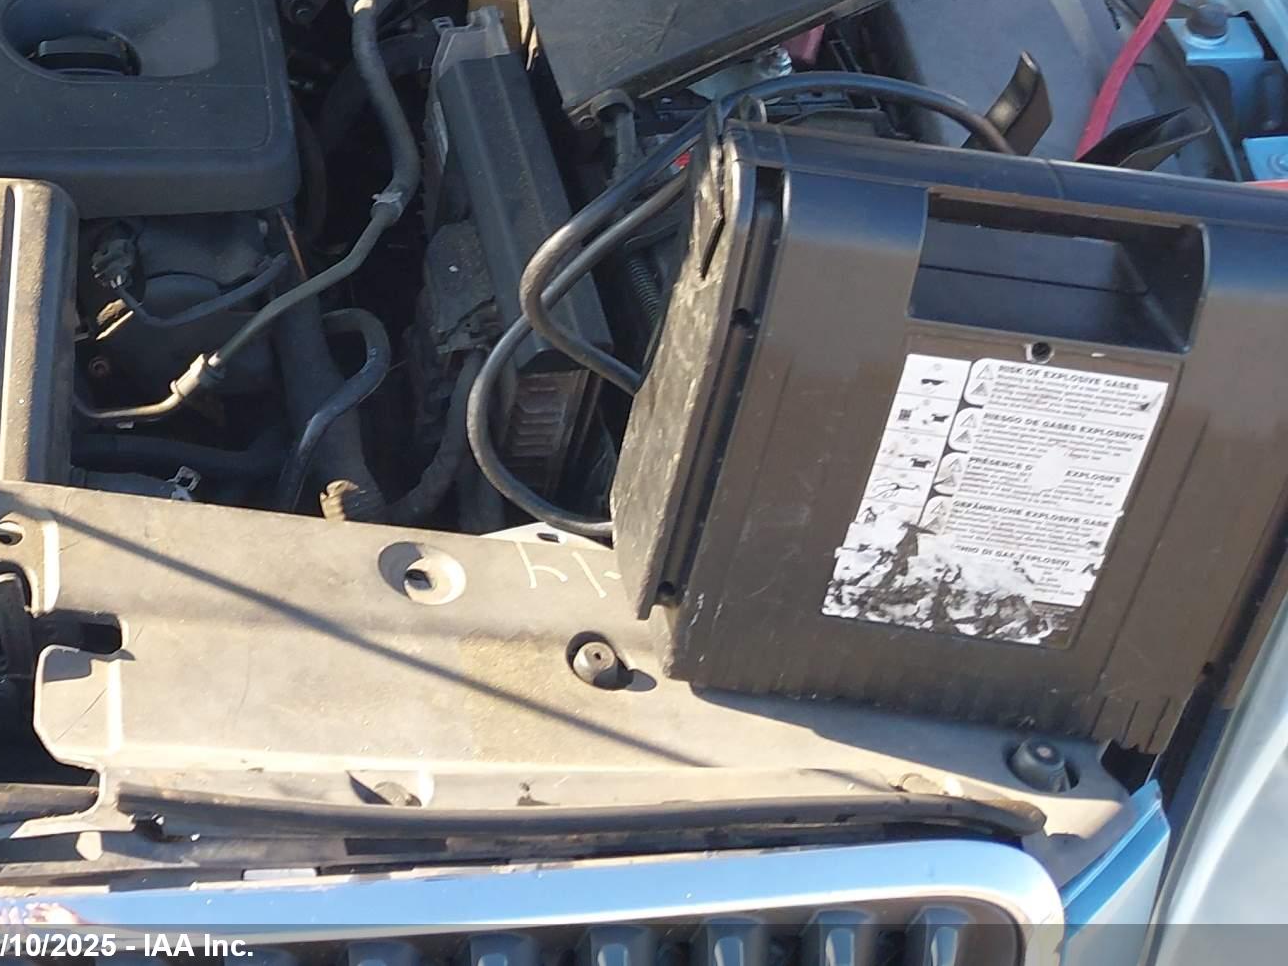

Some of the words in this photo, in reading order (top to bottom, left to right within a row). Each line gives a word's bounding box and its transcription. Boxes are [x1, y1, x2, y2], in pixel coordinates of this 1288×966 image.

[998, 365, 1023, 374] RISK
[1026, 368, 1040, 376] OF
[1043, 371, 1100, 385] EXPLOSIVE
[1103, 379, 1139, 390] GASES
[984, 413, 1022, 424] RIESGO
[1025, 418, 1039, 426] DE
[1042, 421, 1076, 432] GASES
[1079, 426, 1144, 440] EXPLOSIVOS
[1065, 470, 1121, 483] EXPLOSIFS
[1025, 511, 1080, 523] EXPLOSIVE
